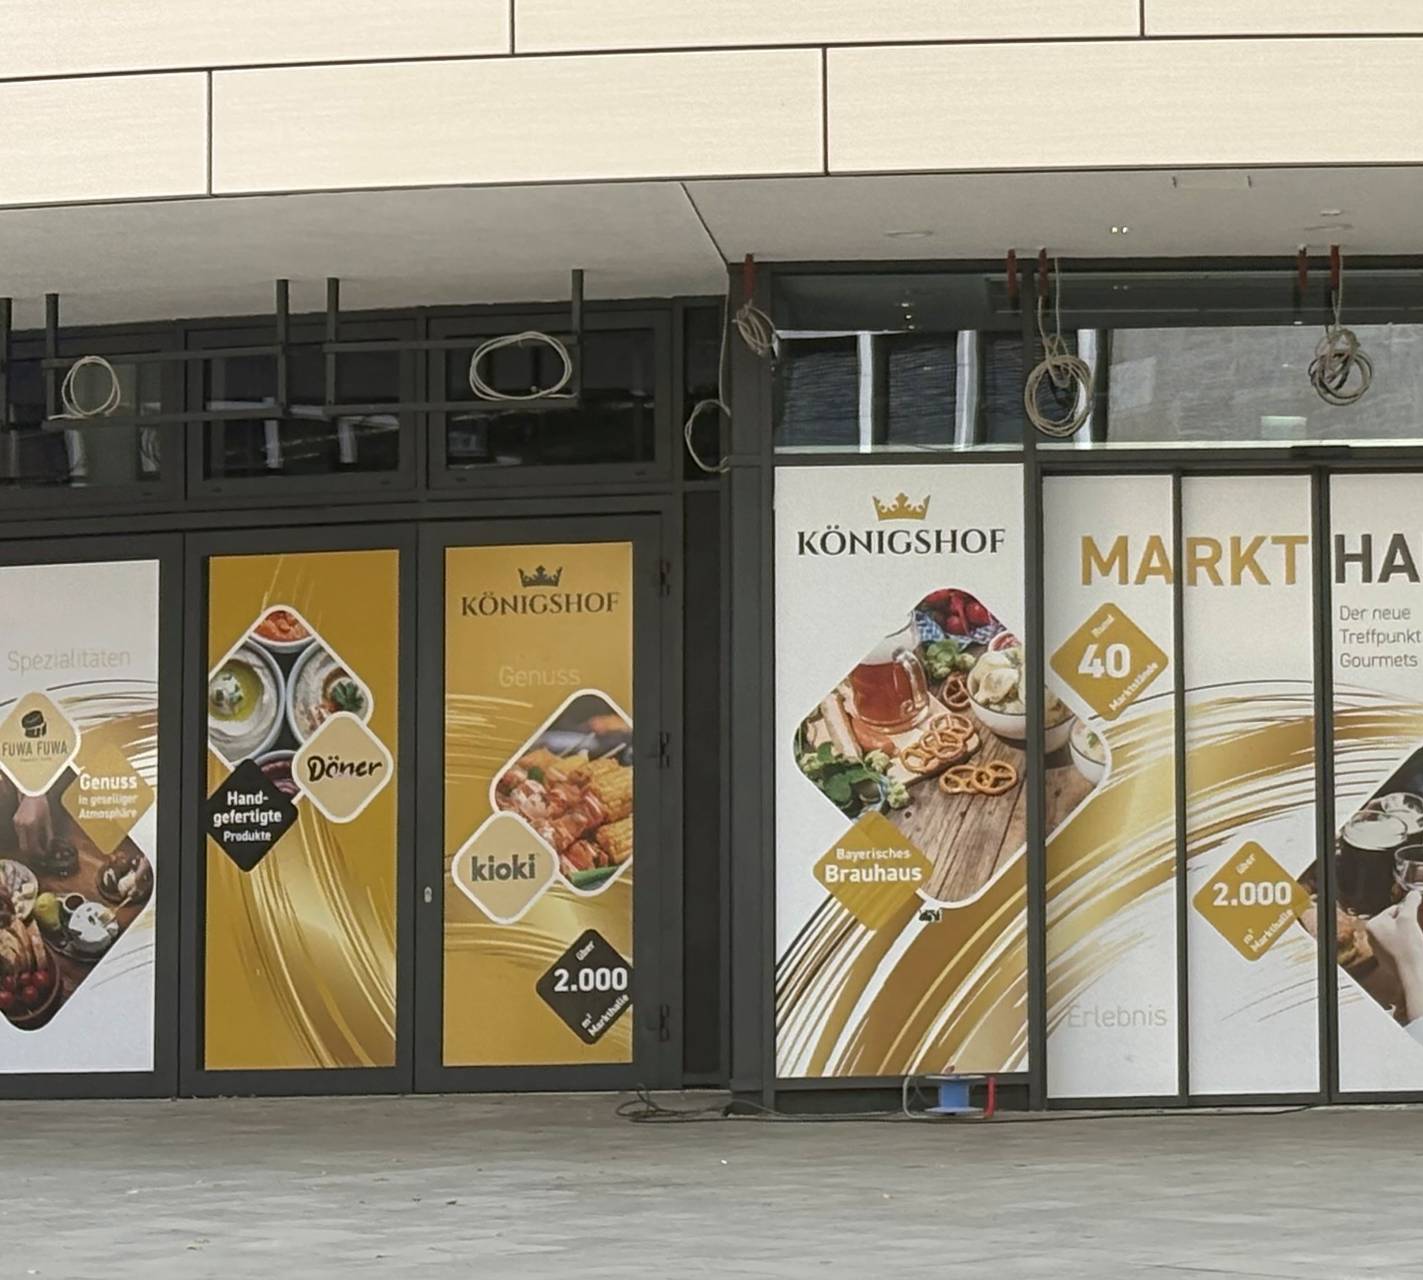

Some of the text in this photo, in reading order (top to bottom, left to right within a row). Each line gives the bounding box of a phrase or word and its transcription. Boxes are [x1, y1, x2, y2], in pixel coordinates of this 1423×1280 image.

[798, 525, 1006, 555] KÖNIGSHOF
[1081, 535, 1309, 586] MARKT
[462, 591, 620, 616] KÖNIGSHOF
[1340, 605, 1411, 621] Der neue
[1340, 628, 1421, 647] Treffpunkt
[7, 648, 130, 675] Spezialitäten
[1078, 643, 1131, 678] 40
[1340, 652, 1418, 668] Gourmets
[500, 666, 581, 687] Genuss
[2, 740, 67, 756] FUWA FUWA
[307, 754, 382, 782] Döner
[79, 774, 138, 790] Genuss
[78, 795, 88, 805] in
[227, 790, 269, 806] Hand-
[213, 808, 282, 827] gefertigte
[223, 830, 271, 842] Produkte
[836, 848, 912, 862] Bayerisches
[471, 854, 536, 882] kioki
[825, 864, 923, 883] Brauhaus
[1212, 882, 1292, 906] 2.000
[1251, 909, 1293, 952] Markthalle
[554, 967, 628, 992] 2.000
[587, 994, 629, 1037] Markthalle
[1068, 1004, 1167, 1028] Erlebnis
